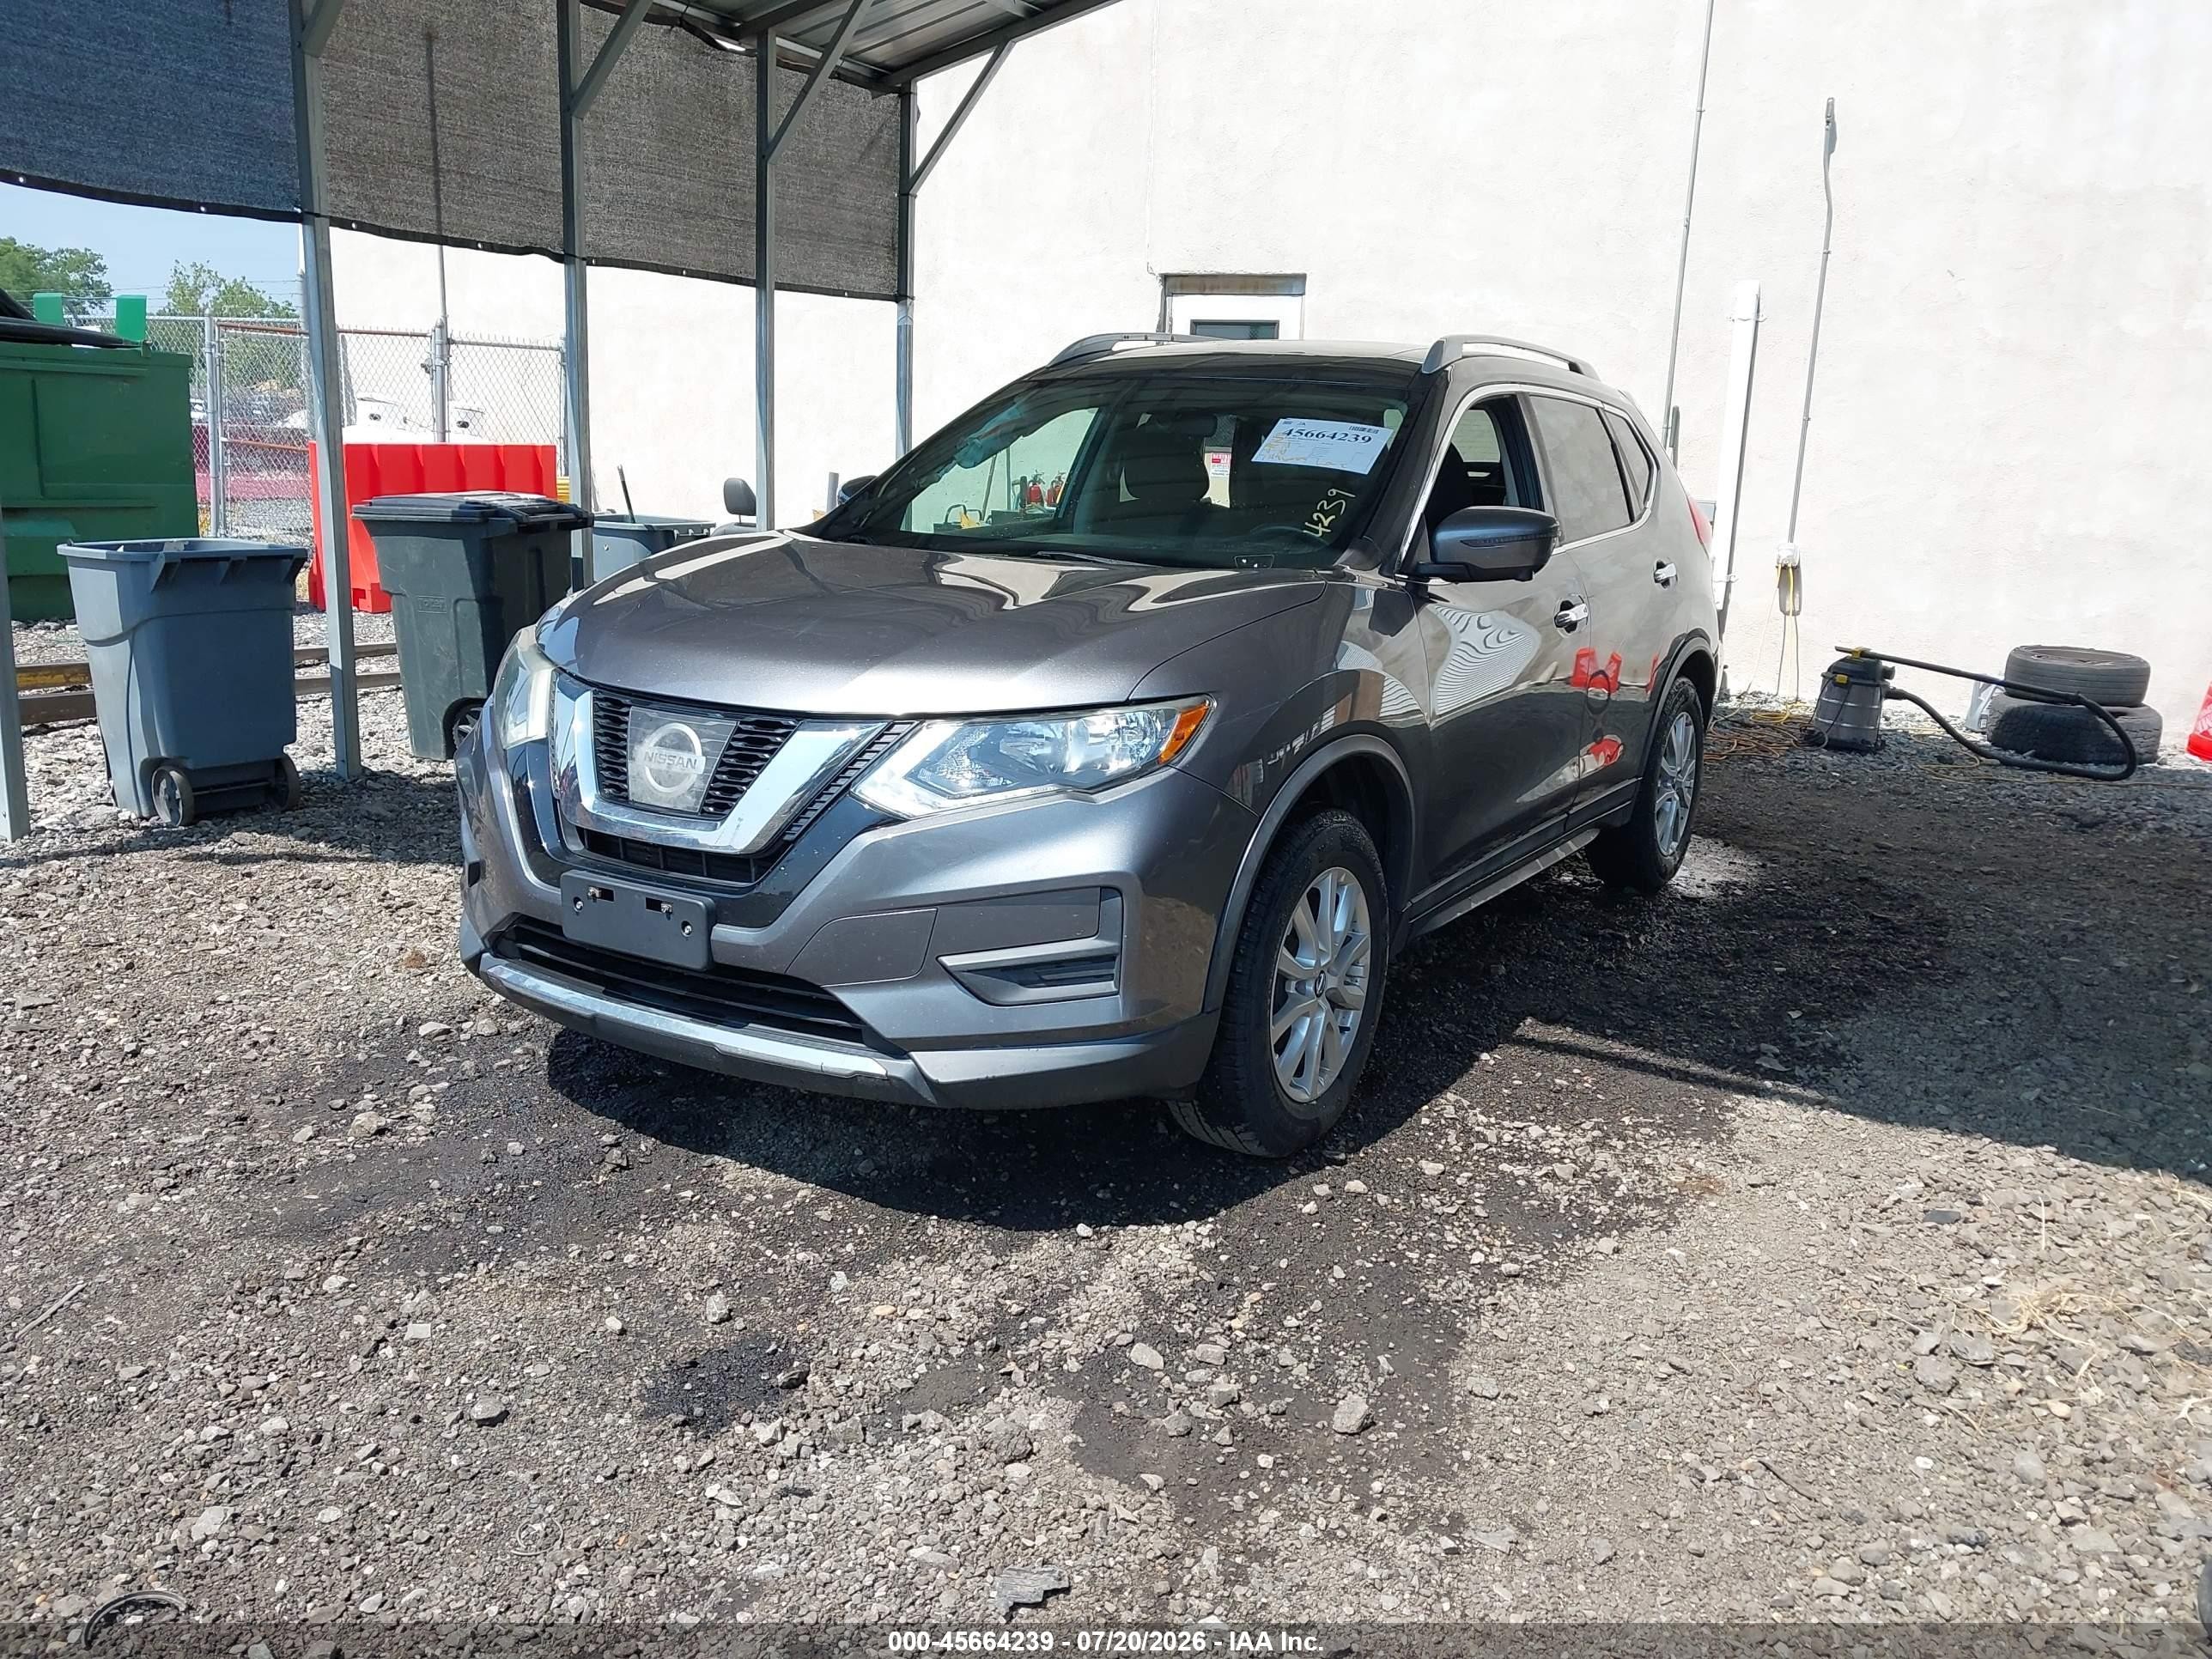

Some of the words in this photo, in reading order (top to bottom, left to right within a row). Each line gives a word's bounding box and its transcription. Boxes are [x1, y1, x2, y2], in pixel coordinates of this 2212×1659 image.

[1284, 428, 1372, 444] 45664239
[1303, 488, 1356, 538] 4239
[644, 750, 698, 770] NISSAN
